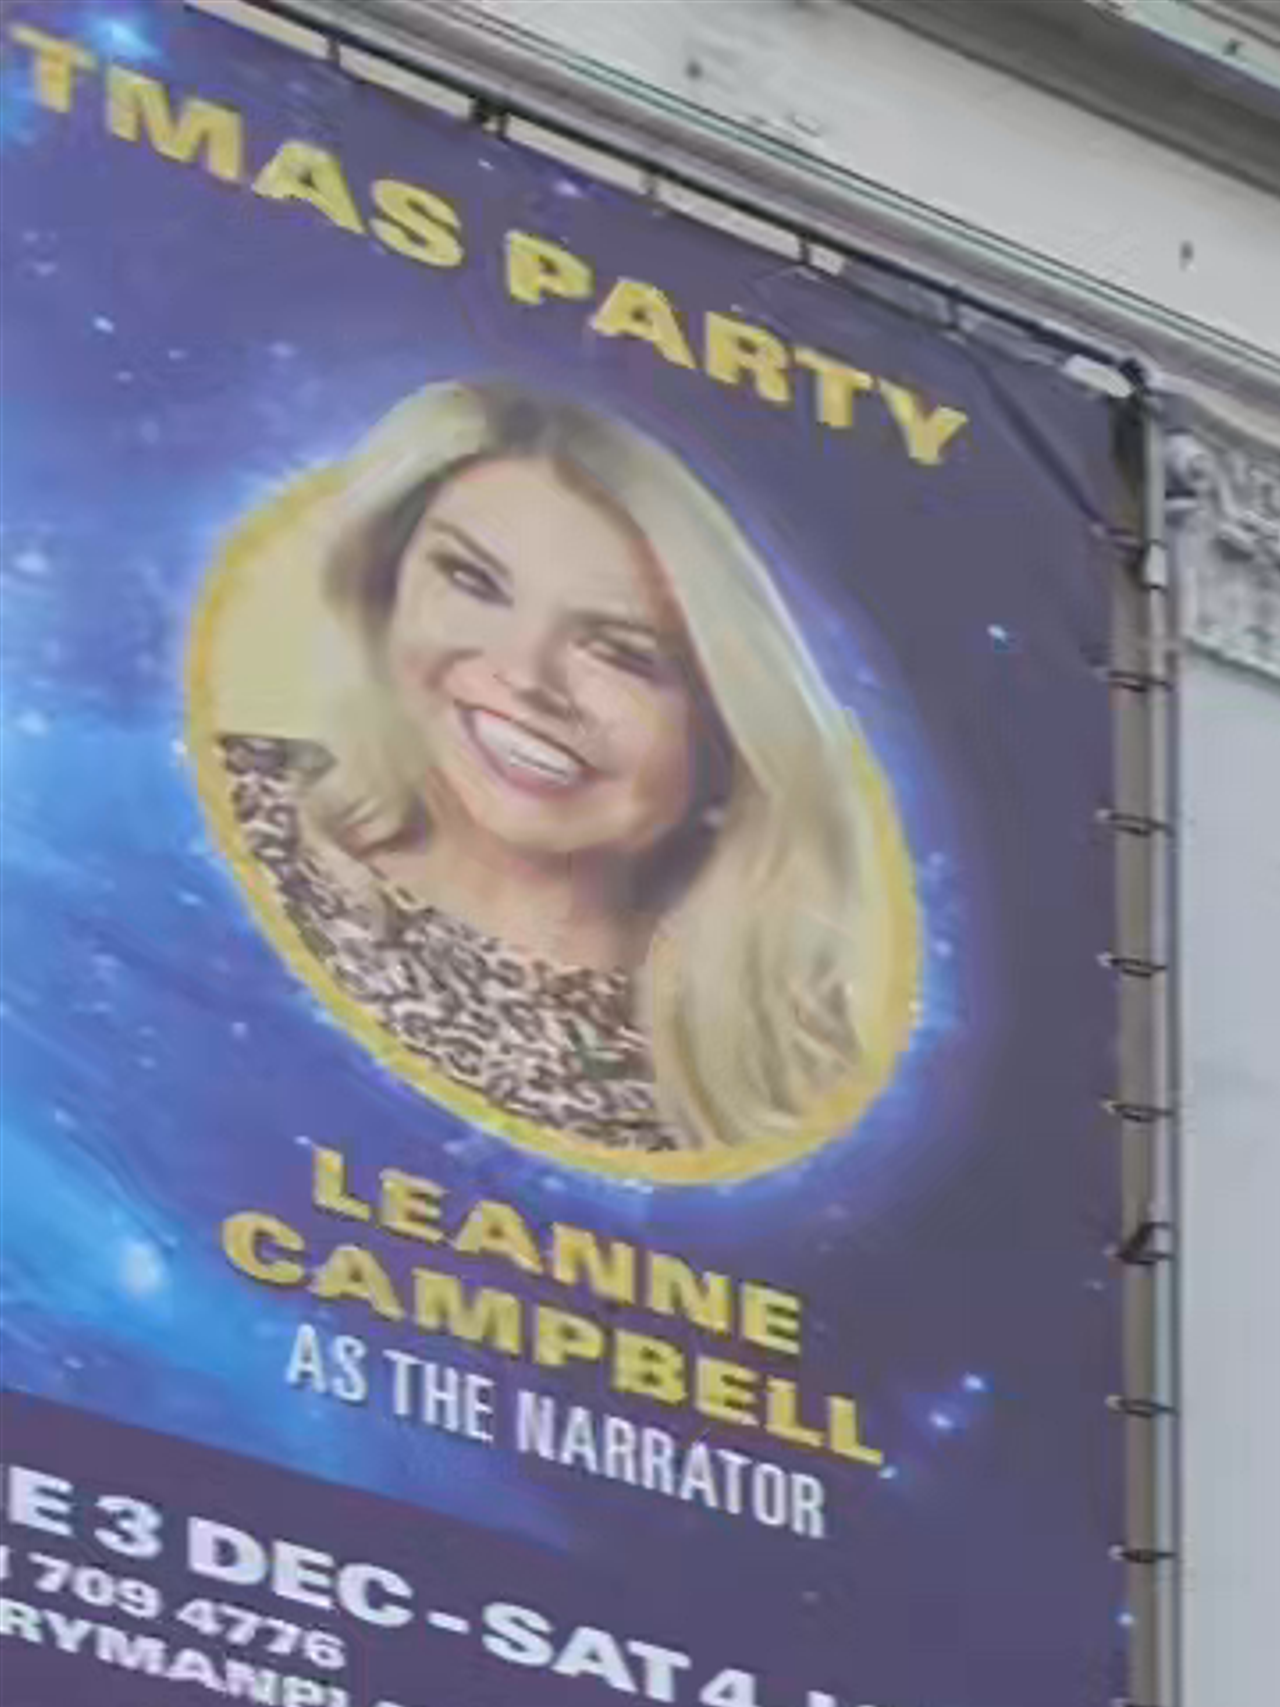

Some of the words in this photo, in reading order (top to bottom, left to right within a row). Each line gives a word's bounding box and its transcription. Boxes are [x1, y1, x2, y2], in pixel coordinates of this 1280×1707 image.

[506, 229, 968, 465] PARTY
[221, 1211, 884, 1466] CAMPBELL
[311, 1147, 803, 1354] LEANNE
[286, 1323, 367, 1403] AS
[382, 1349, 495, 1442] THE
[516, 1388, 826, 1540] NARRATOR
[28, 1551, 163, 1620] 709
[176, 1599, 347, 1670] 4776
[94, 1495, 163, 1560] 3
[186, 1515, 414, 1627] DEC
[481, 1601, 692, 1702] SAT
